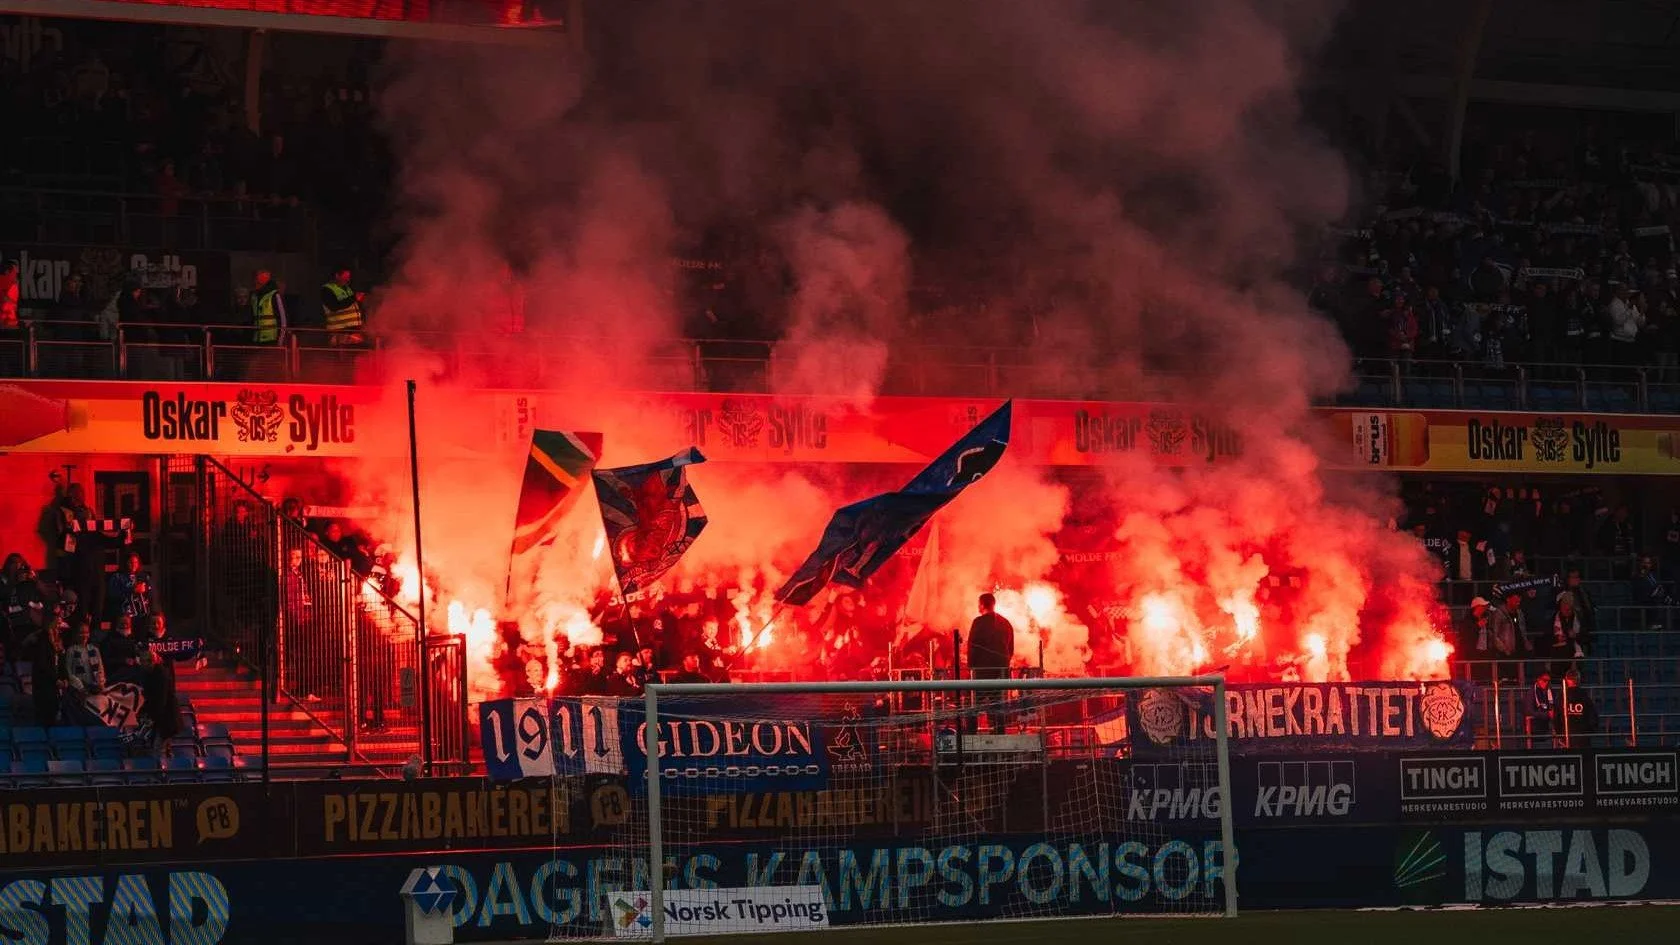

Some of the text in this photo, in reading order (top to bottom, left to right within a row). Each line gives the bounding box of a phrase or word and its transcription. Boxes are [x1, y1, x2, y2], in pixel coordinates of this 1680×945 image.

[143, 391, 226, 441] Oskar
[289, 393, 354, 451] Sylte
[1075, 409, 1141, 453] Oskar
[1468, 418, 1528, 461] Oskar
[1572, 420, 1621, 469] Sylte
[149, 640, 194, 652] MOLDE FK
[487, 706, 610, 763] 1911
[636, 719, 813, 759] GIDEON
[1407, 766, 1479, 790] TINGH
[1505, 764, 1576, 788] TINGH
[1602, 762, 1671, 785] TINGH
[323, 787, 571, 842] PIZZABAKEREN
[1128, 786, 1222, 820] KPMG
[1254, 782, 1352, 817] KPMG
[1400, 802, 1488, 813] MERKEVARESTUDIO
[1500, 799, 1584, 811] MERKEVARESTUDIO
[1596, 795, 1679, 808] MERKEVARESTUDIO
[207, 803, 230, 833] PB
[1464, 830, 1651, 900] ISTAD
[0, 871, 231, 945] STAD
[662, 898, 824, 924] Norsk Tipping
